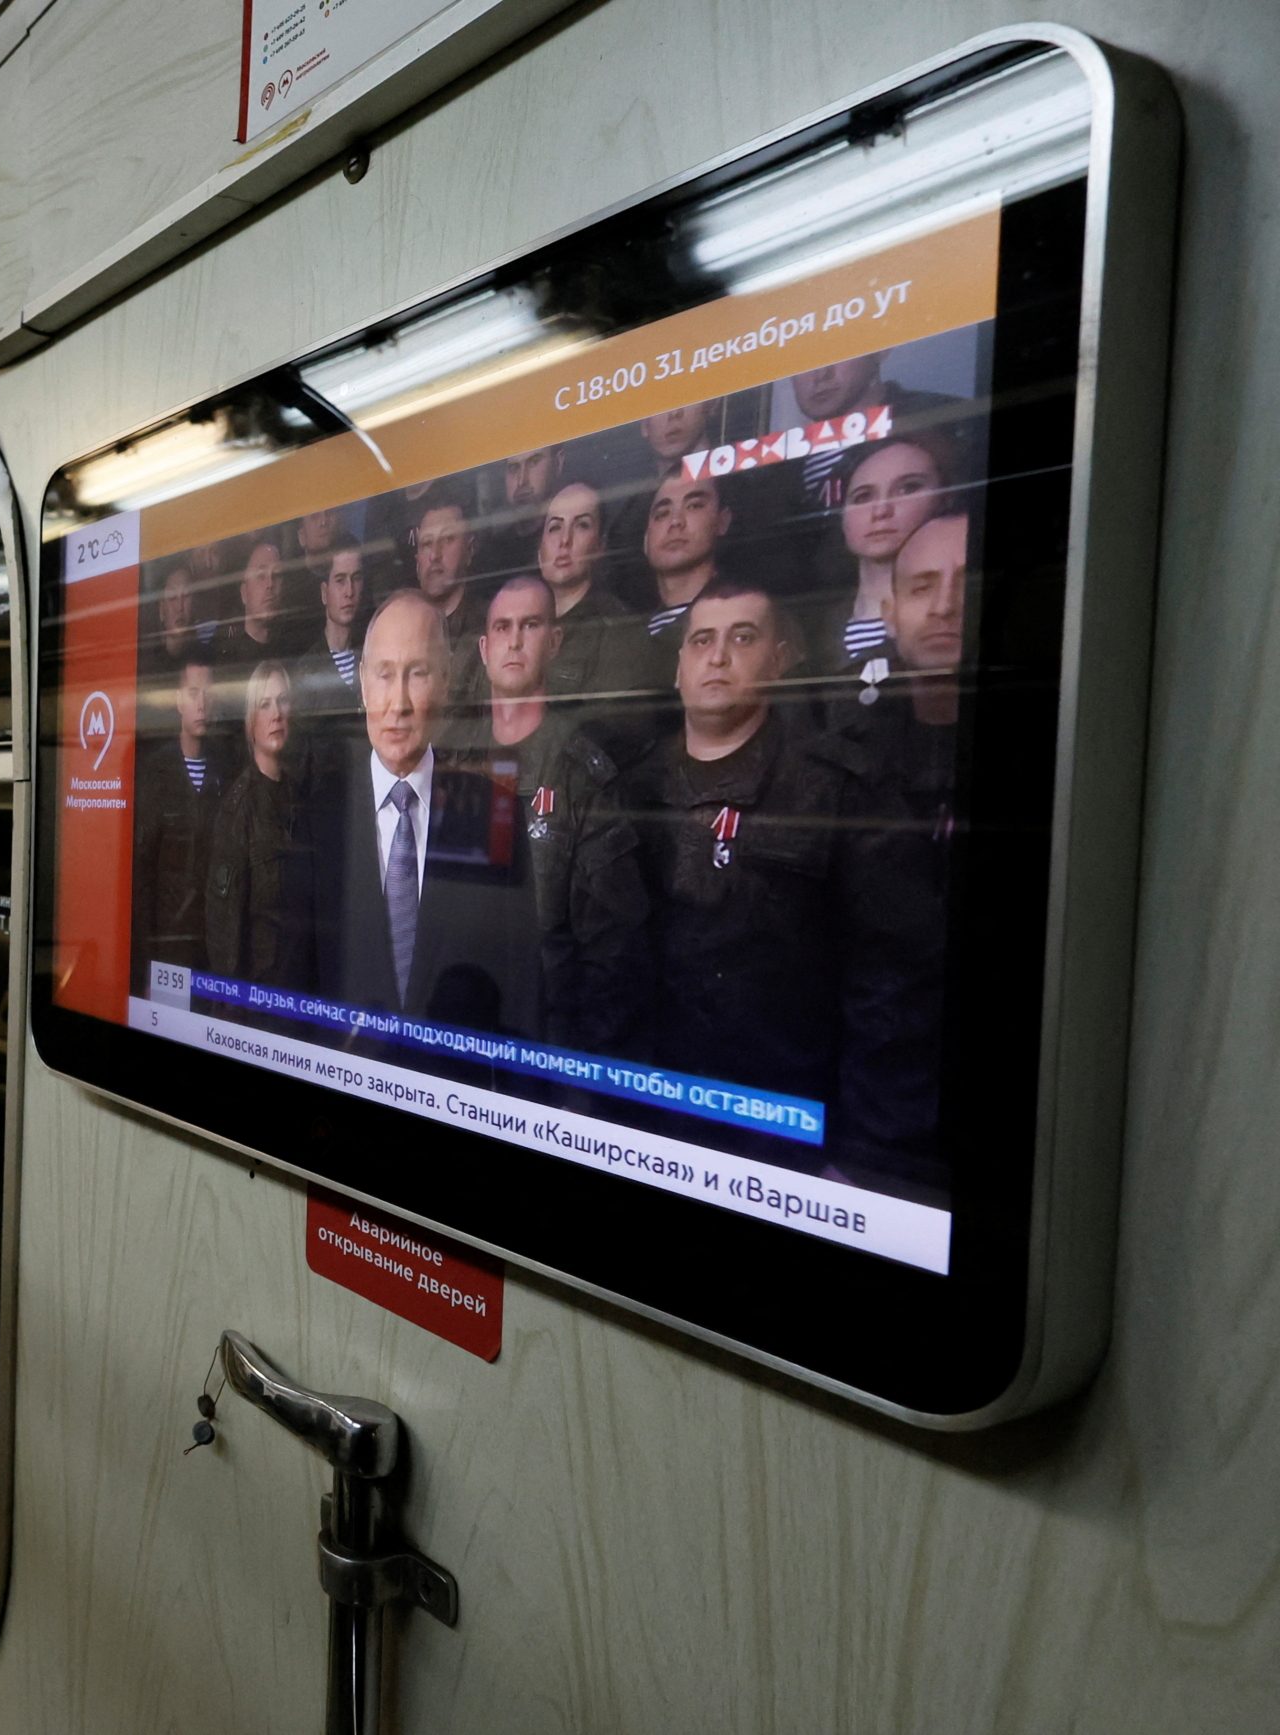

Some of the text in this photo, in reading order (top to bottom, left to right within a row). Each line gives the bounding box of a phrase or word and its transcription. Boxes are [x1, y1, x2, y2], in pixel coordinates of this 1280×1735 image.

[554, 280, 913, 411] С 18:00 31 декабря до ут
[65, 794, 127, 812] Метрополитен
[70, 776, 122, 791] Московский
[151, 1011, 158, 1026] 5
[196, 976, 241, 998] счастья.
[299, 999, 346, 1024] сейчас
[349, 1010, 399, 1035] самый
[403, 1021, 516, 1061] подходящий
[521, 1047, 603, 1081] момент
[607, 1066, 684, 1101] чтобы
[689, 1085, 820, 1132] оставить
[206, 1026, 866, 1234] Каховская линия метро закрыта. Станции «Каширская» и «Варшав
[318, 1227, 487, 1318] открывание дверей
[349, 1211, 444, 1267] Аварийное
